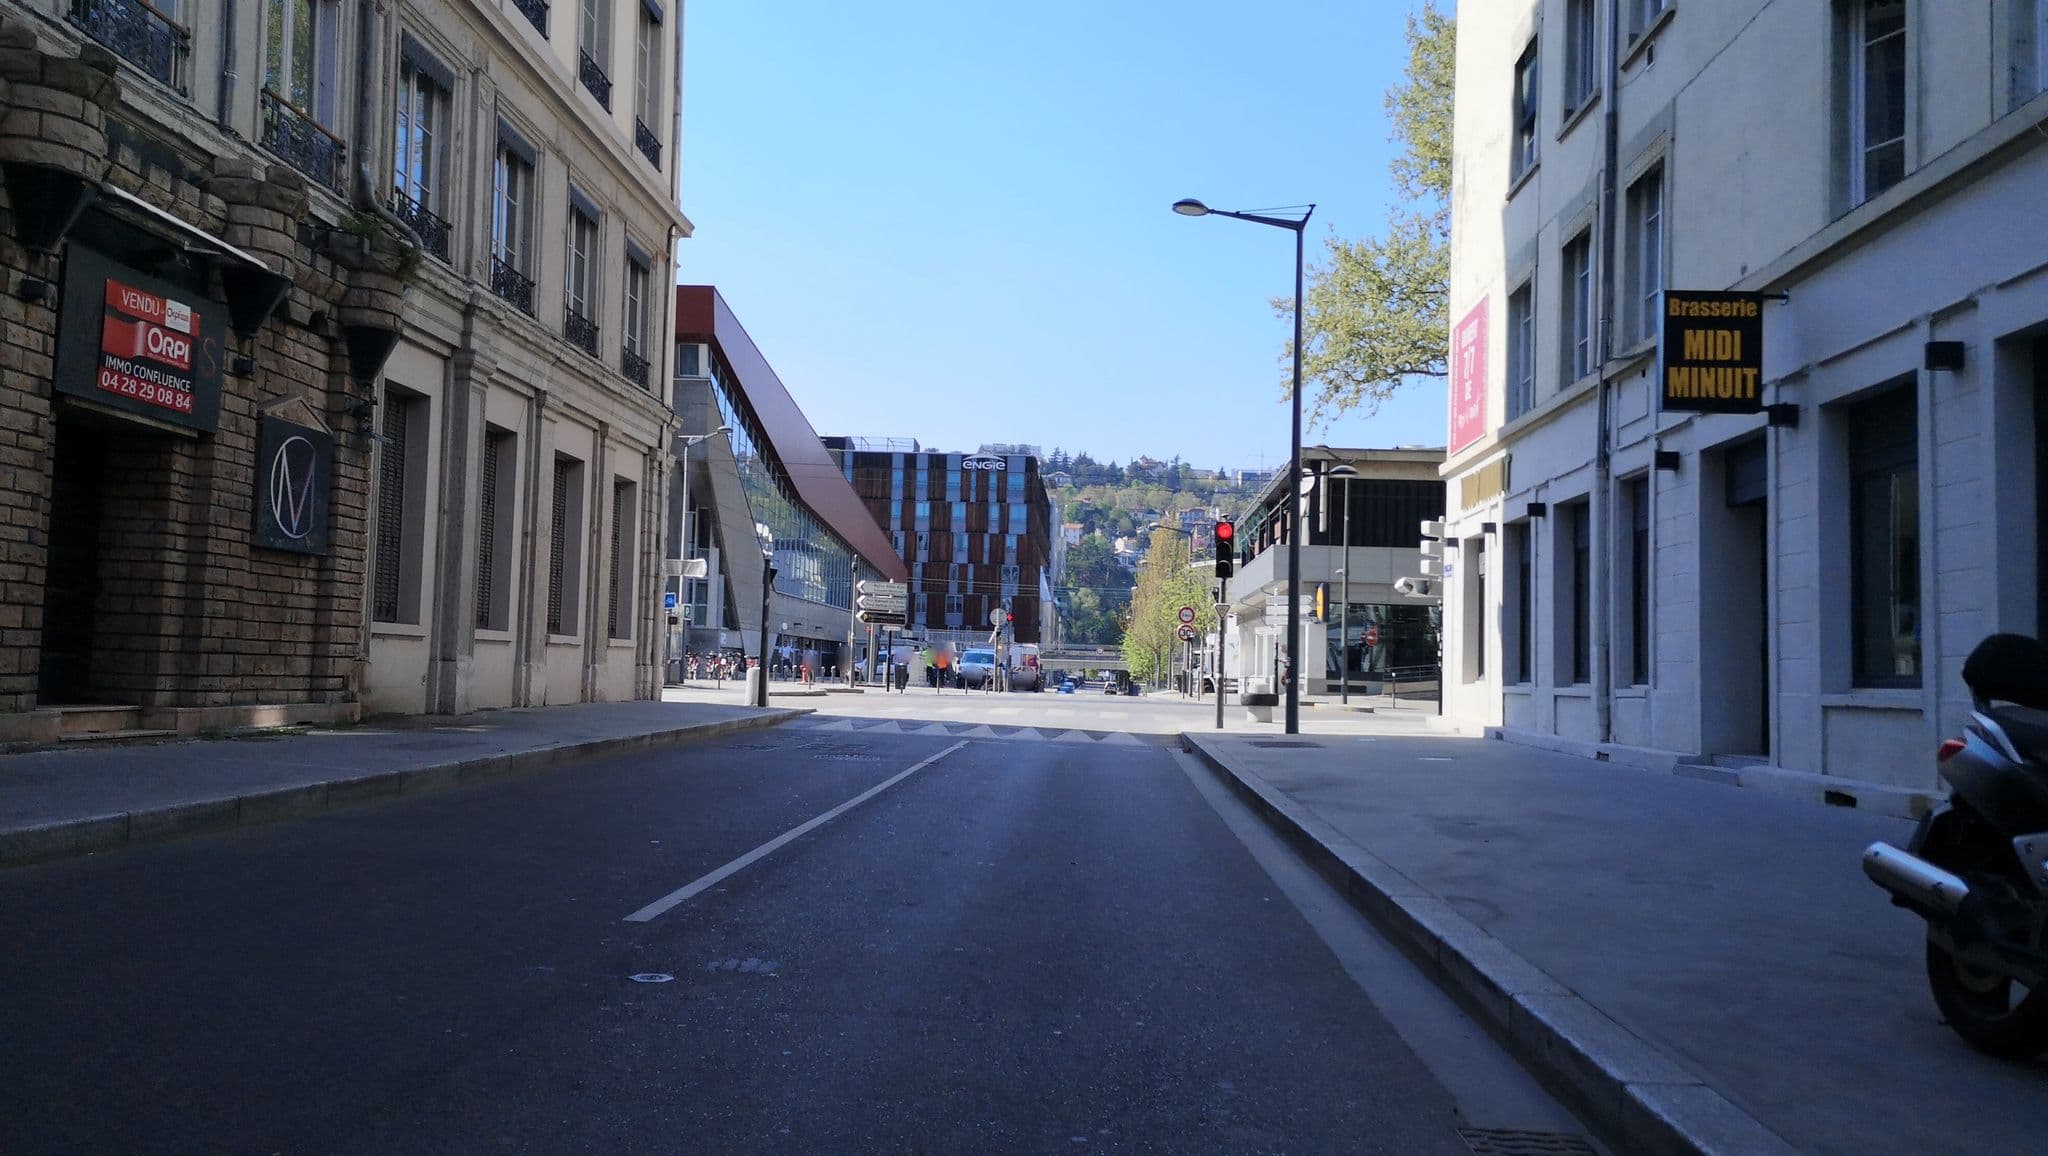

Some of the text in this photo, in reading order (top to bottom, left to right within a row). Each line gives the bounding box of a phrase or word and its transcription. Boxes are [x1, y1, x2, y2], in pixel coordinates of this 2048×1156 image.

[122, 289, 160, 316] VENDU
[1669, 297, 1758, 317] Brasserie
[147, 327, 189, 363] ORPI
[1683, 329, 1742, 361] MIDI
[102, 372, 191, 409] 04 28 29 08 84
[105, 355, 132, 375] IMMO
[133, 364, 192, 393] CONFLUENCE
[1668, 366, 1759, 399] MINUIT
